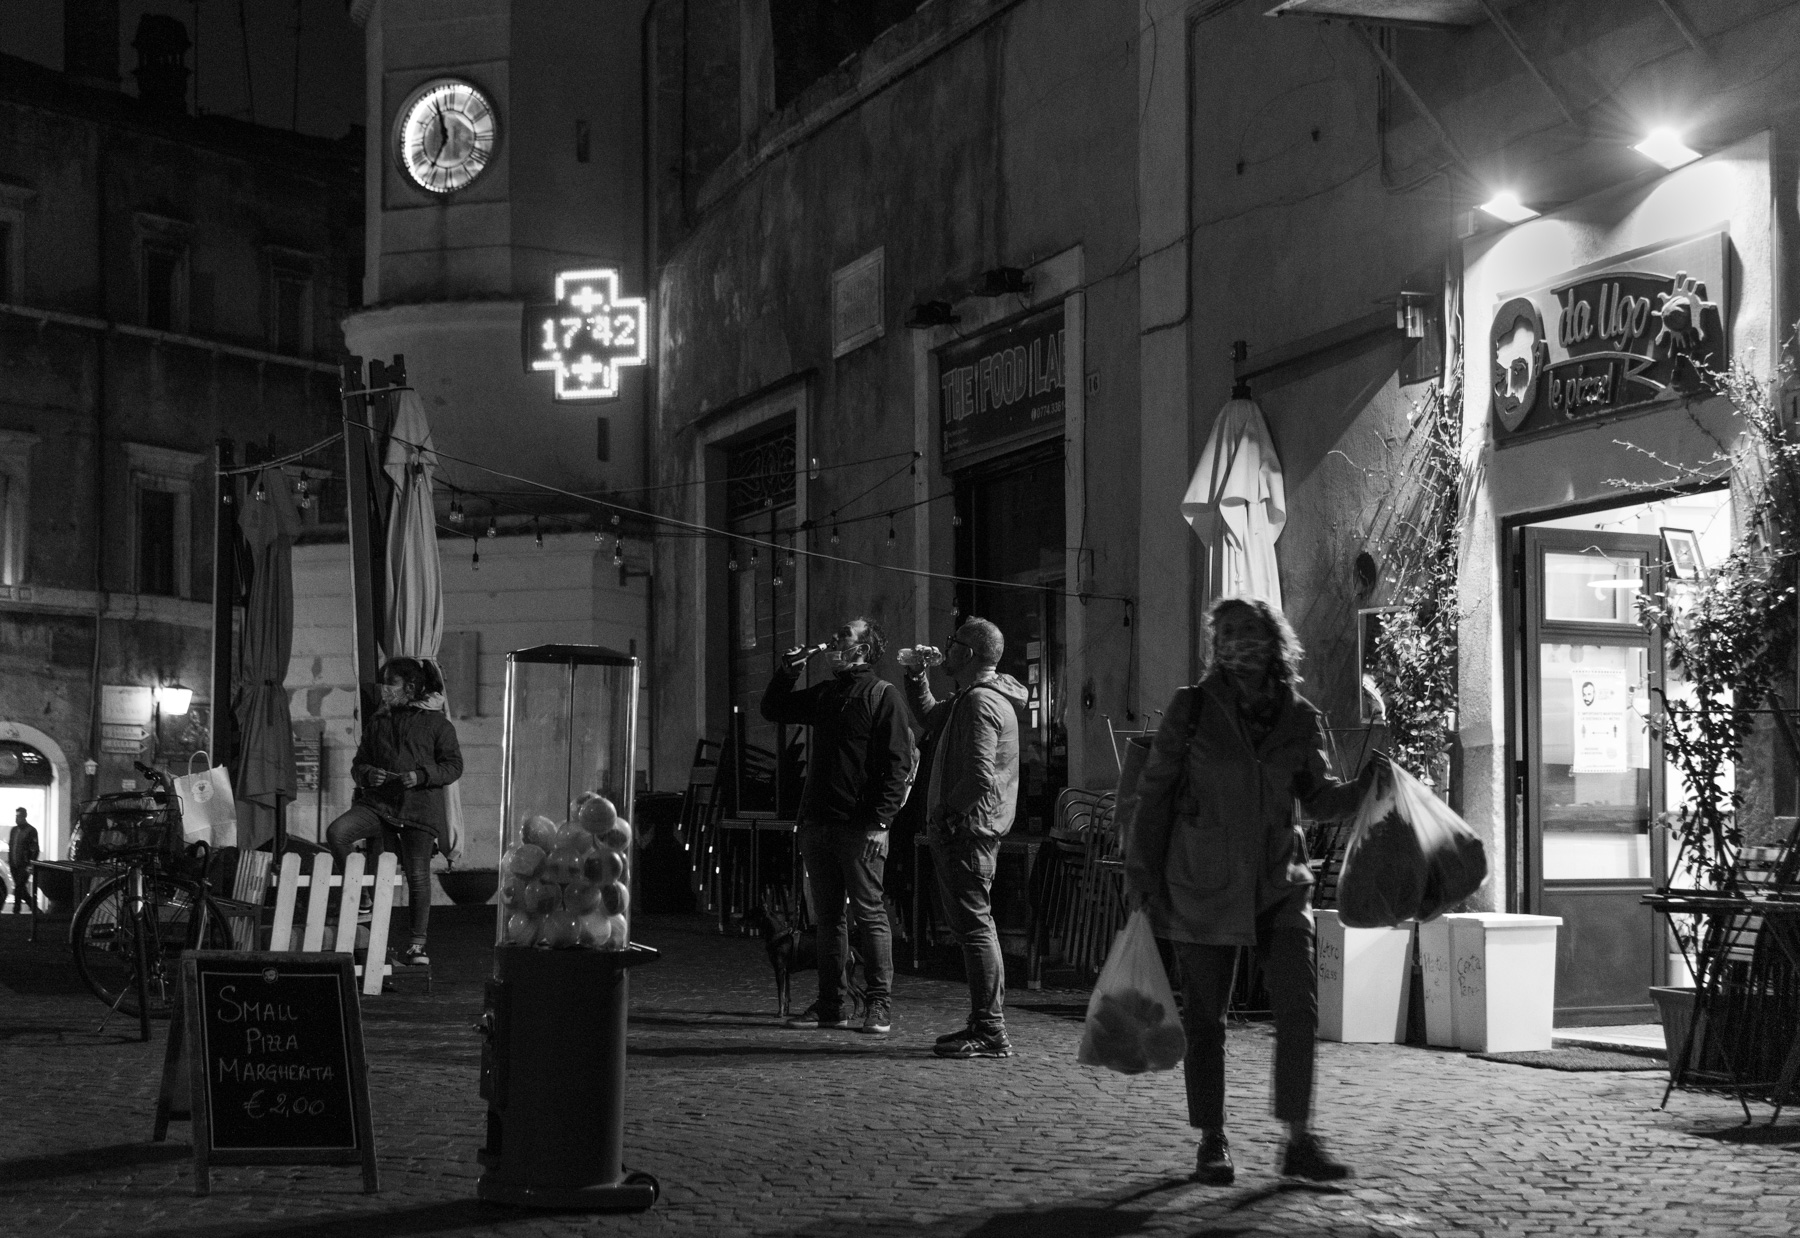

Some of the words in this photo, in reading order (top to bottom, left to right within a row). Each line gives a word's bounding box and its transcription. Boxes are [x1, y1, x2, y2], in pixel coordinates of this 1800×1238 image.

[1558, 288, 1594, 348] da
[1599, 282, 1651, 351] Ugo
[941, 366, 974, 425] THE
[979, 345, 1027, 414] FOOD
[1548, 369, 1563, 410] le
[245, 1027, 299, 1054] PIZZA
